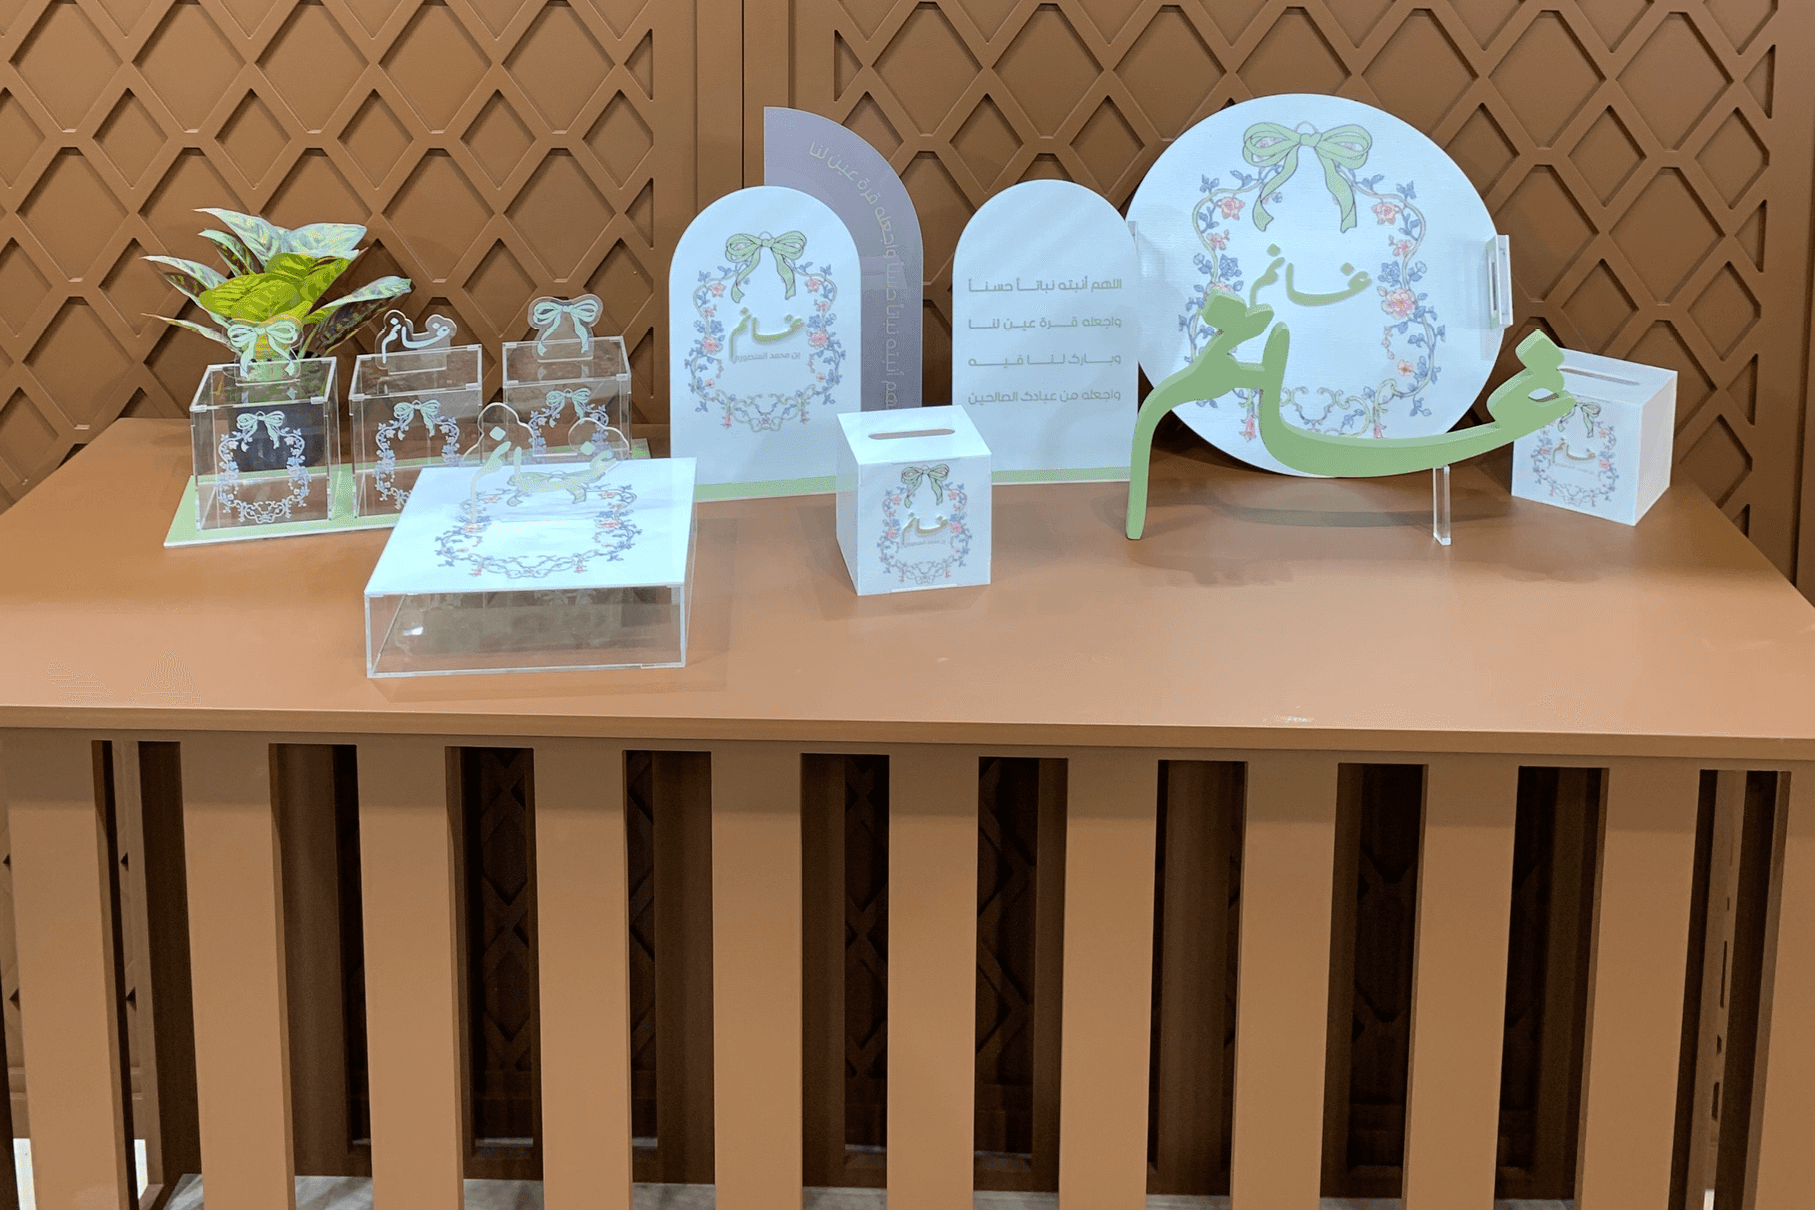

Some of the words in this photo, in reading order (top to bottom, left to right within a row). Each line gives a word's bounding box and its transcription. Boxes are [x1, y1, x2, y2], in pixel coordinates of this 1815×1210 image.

[1058, 275, 1088, 293] أنبته
[1091, 278, 1122, 293] اللهم
[968, 318, 1000, 330] لنا
[1003, 318, 1036, 331] عين
[1039, 316, 1078, 330] قرة
[1082, 316, 1122, 330] واجعله
[729, 306, 804, 358] غانم
[381, 317, 451, 365] غانم
[968, 354, 1024, 368] فيه
[1027, 354, 1065, 366] لنا
[1068, 353, 1122, 366] وبارك
[968, 391, 1018, 405] الصالحين
[1020, 390, 1057, 404] عبادك
[1059, 390, 1078, 403] من
[1081, 389, 1121, 403] واجعله
